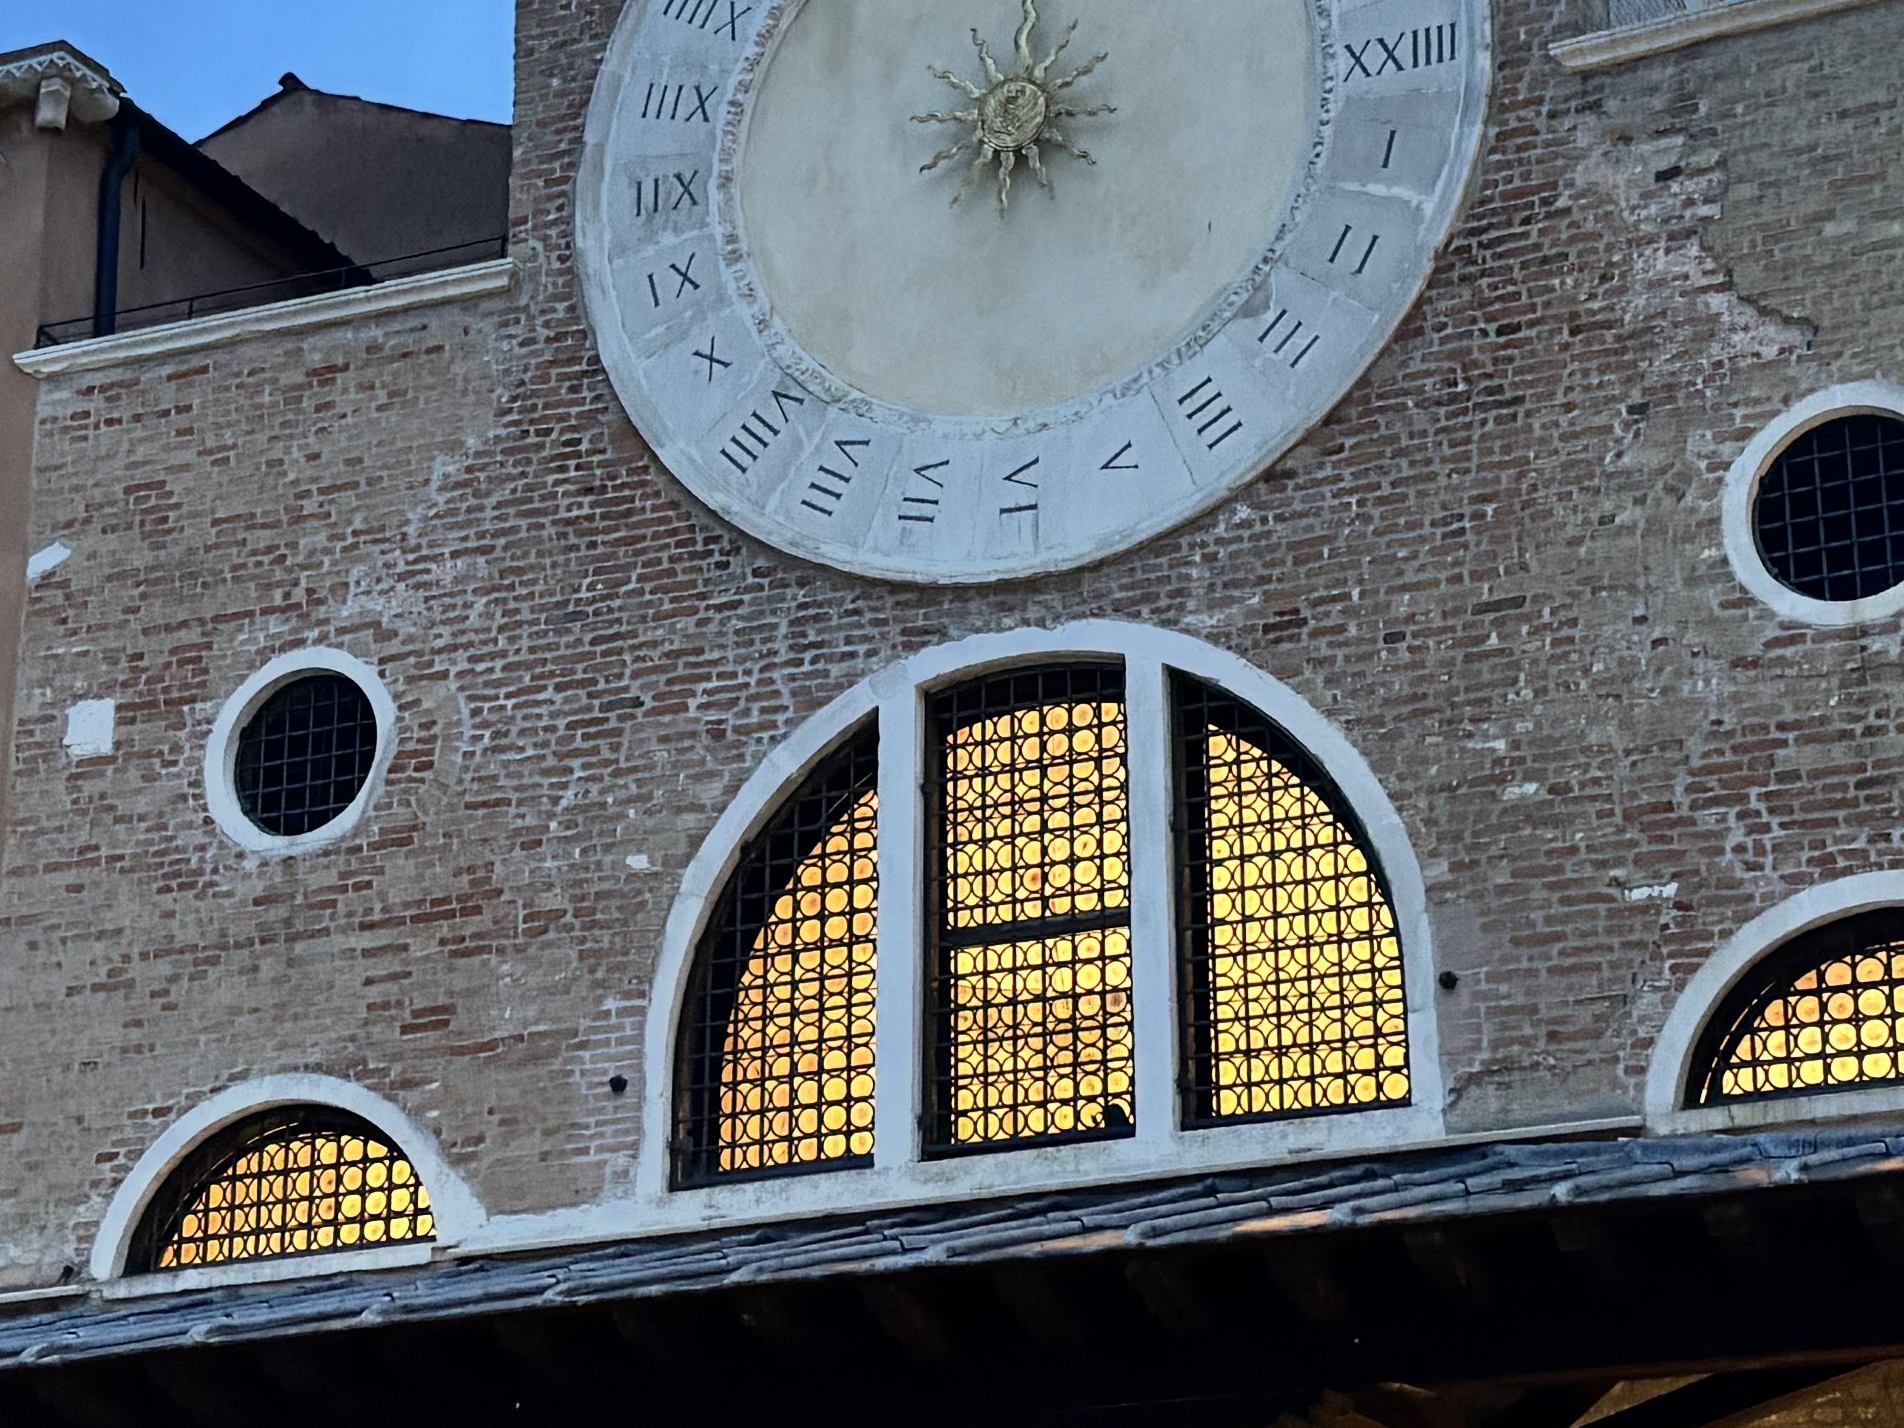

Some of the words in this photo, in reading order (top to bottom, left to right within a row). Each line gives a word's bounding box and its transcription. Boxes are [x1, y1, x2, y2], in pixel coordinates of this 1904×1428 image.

[1343, 21, 1457, 83] XXIIII
[640, 82, 719, 123] XIII
[1381, 129, 1397, 169] I
[1327, 224, 1380, 275] II
[692, 335, 733, 384] X
[1257, 308, 1321, 369] III
[719, 388, 806, 474] VIIII
[1177, 375, 1244, 451] IIII
[800, 438, 872, 518] VIII
[1098, 439, 1140, 471] V
[897, 458, 950, 523] VII
[998, 455, 1040, 517] VI
